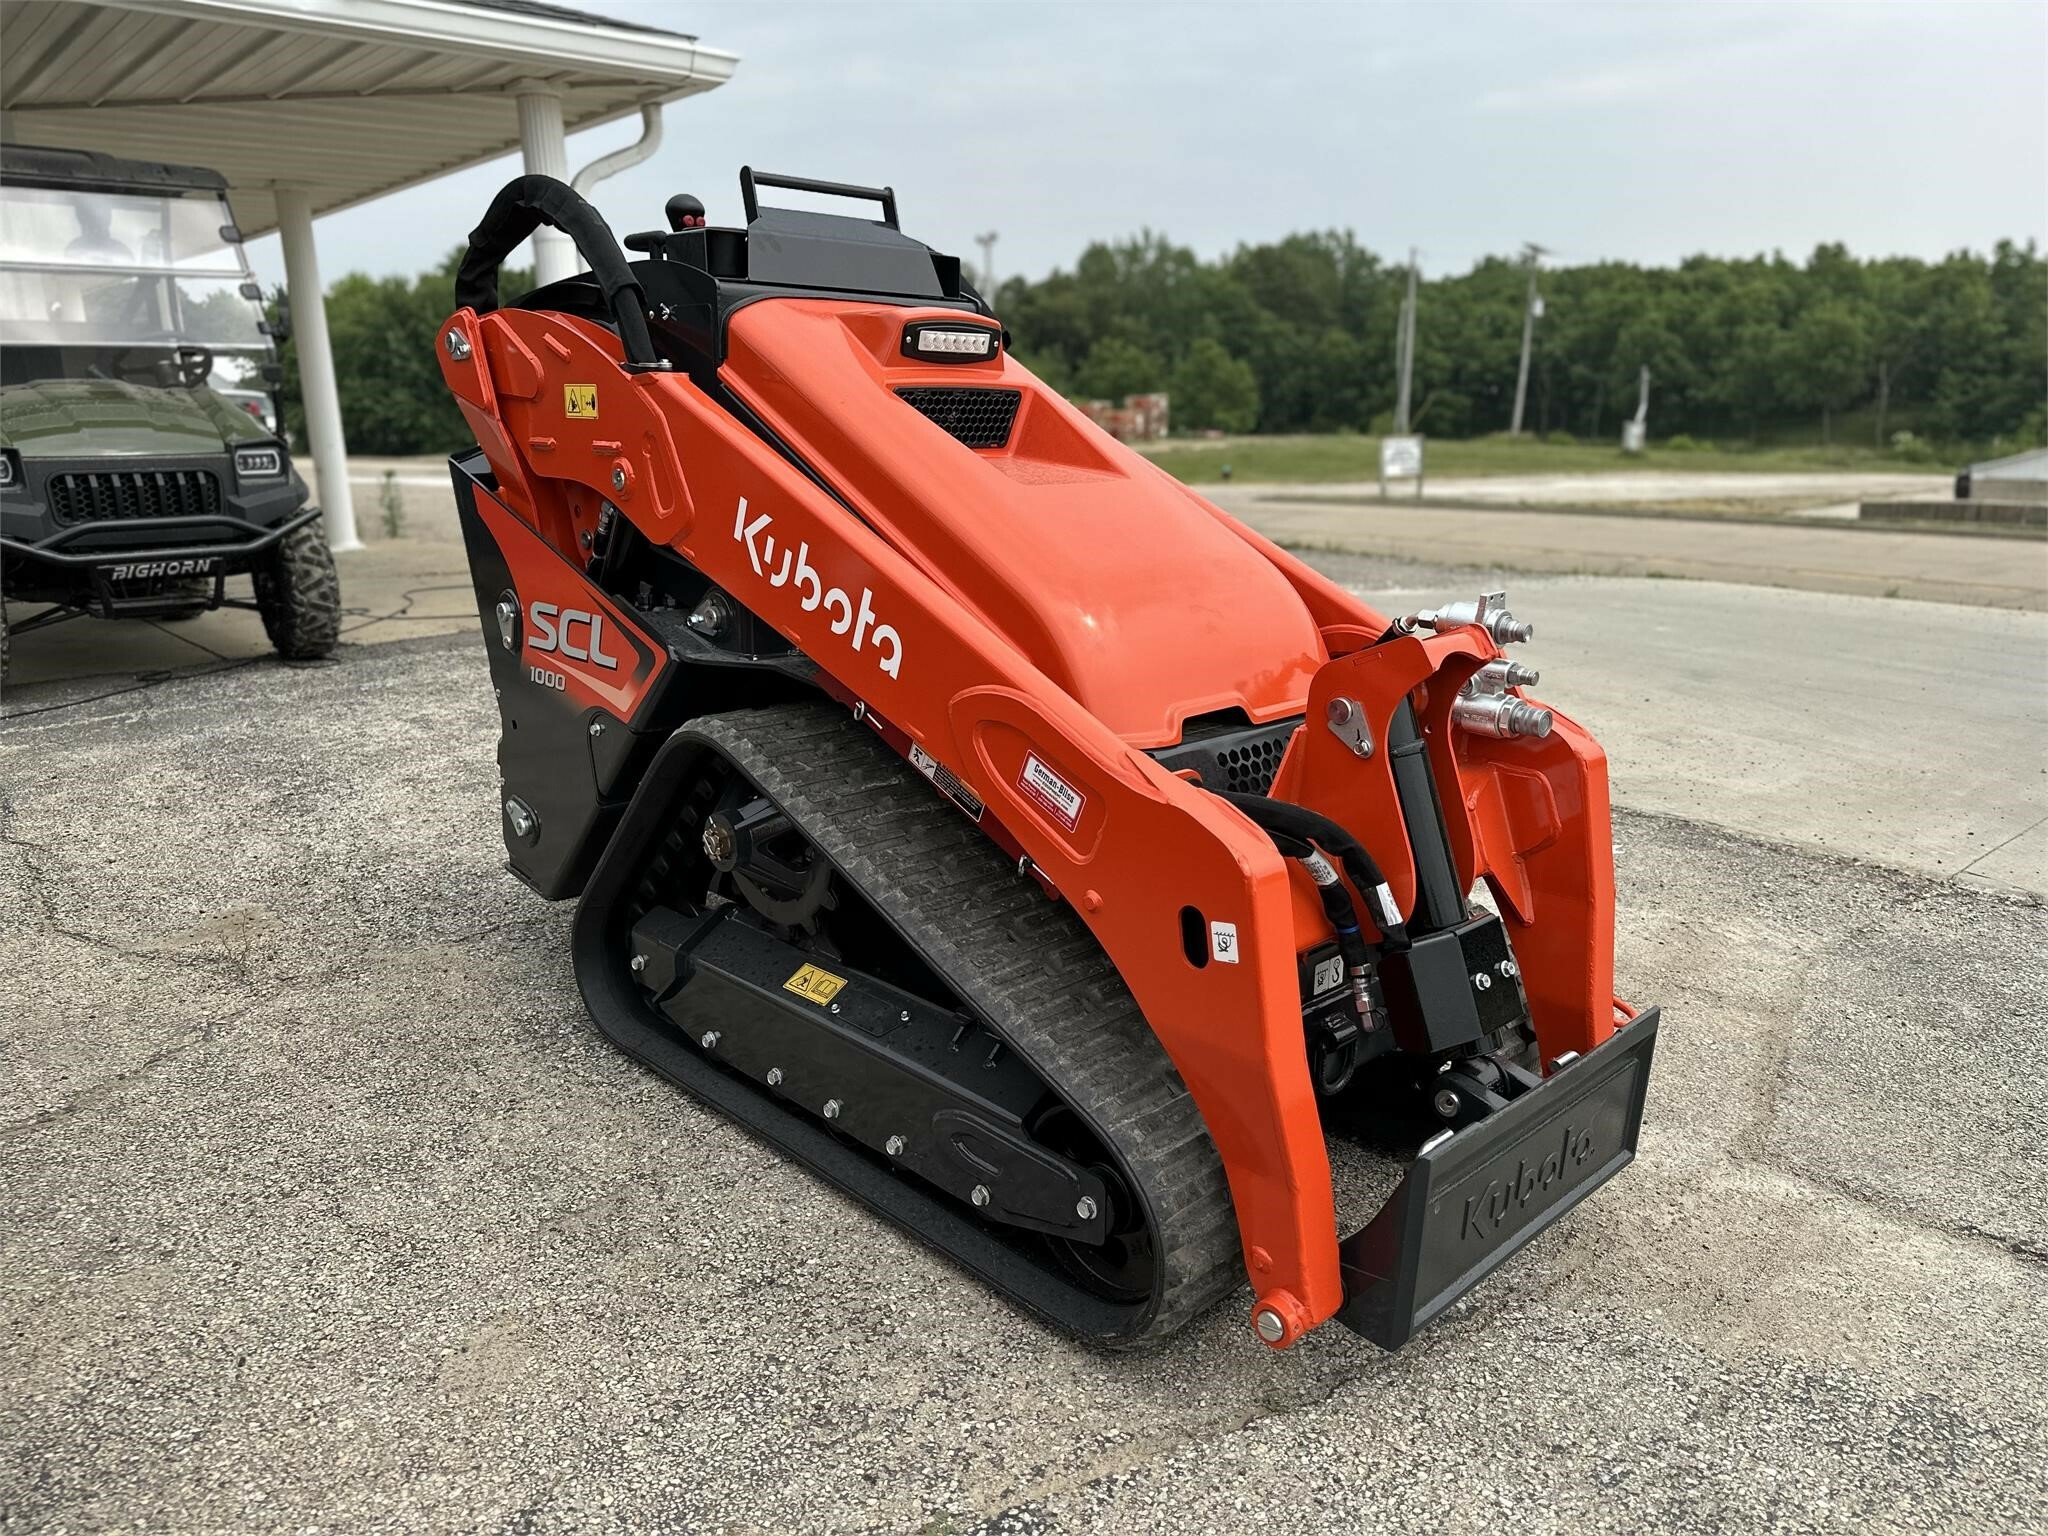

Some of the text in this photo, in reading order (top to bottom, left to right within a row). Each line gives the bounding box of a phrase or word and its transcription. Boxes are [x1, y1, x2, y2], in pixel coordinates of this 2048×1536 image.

[112, 559, 211, 580] BIGHORN
[733, 496, 903, 681] Kubota
[528, 601, 618, 671] SCL
[530, 666, 566, 691] 1000
[1034, 763, 1075, 804] German-Bliss
[1461, 1124, 1594, 1241] Kubota
